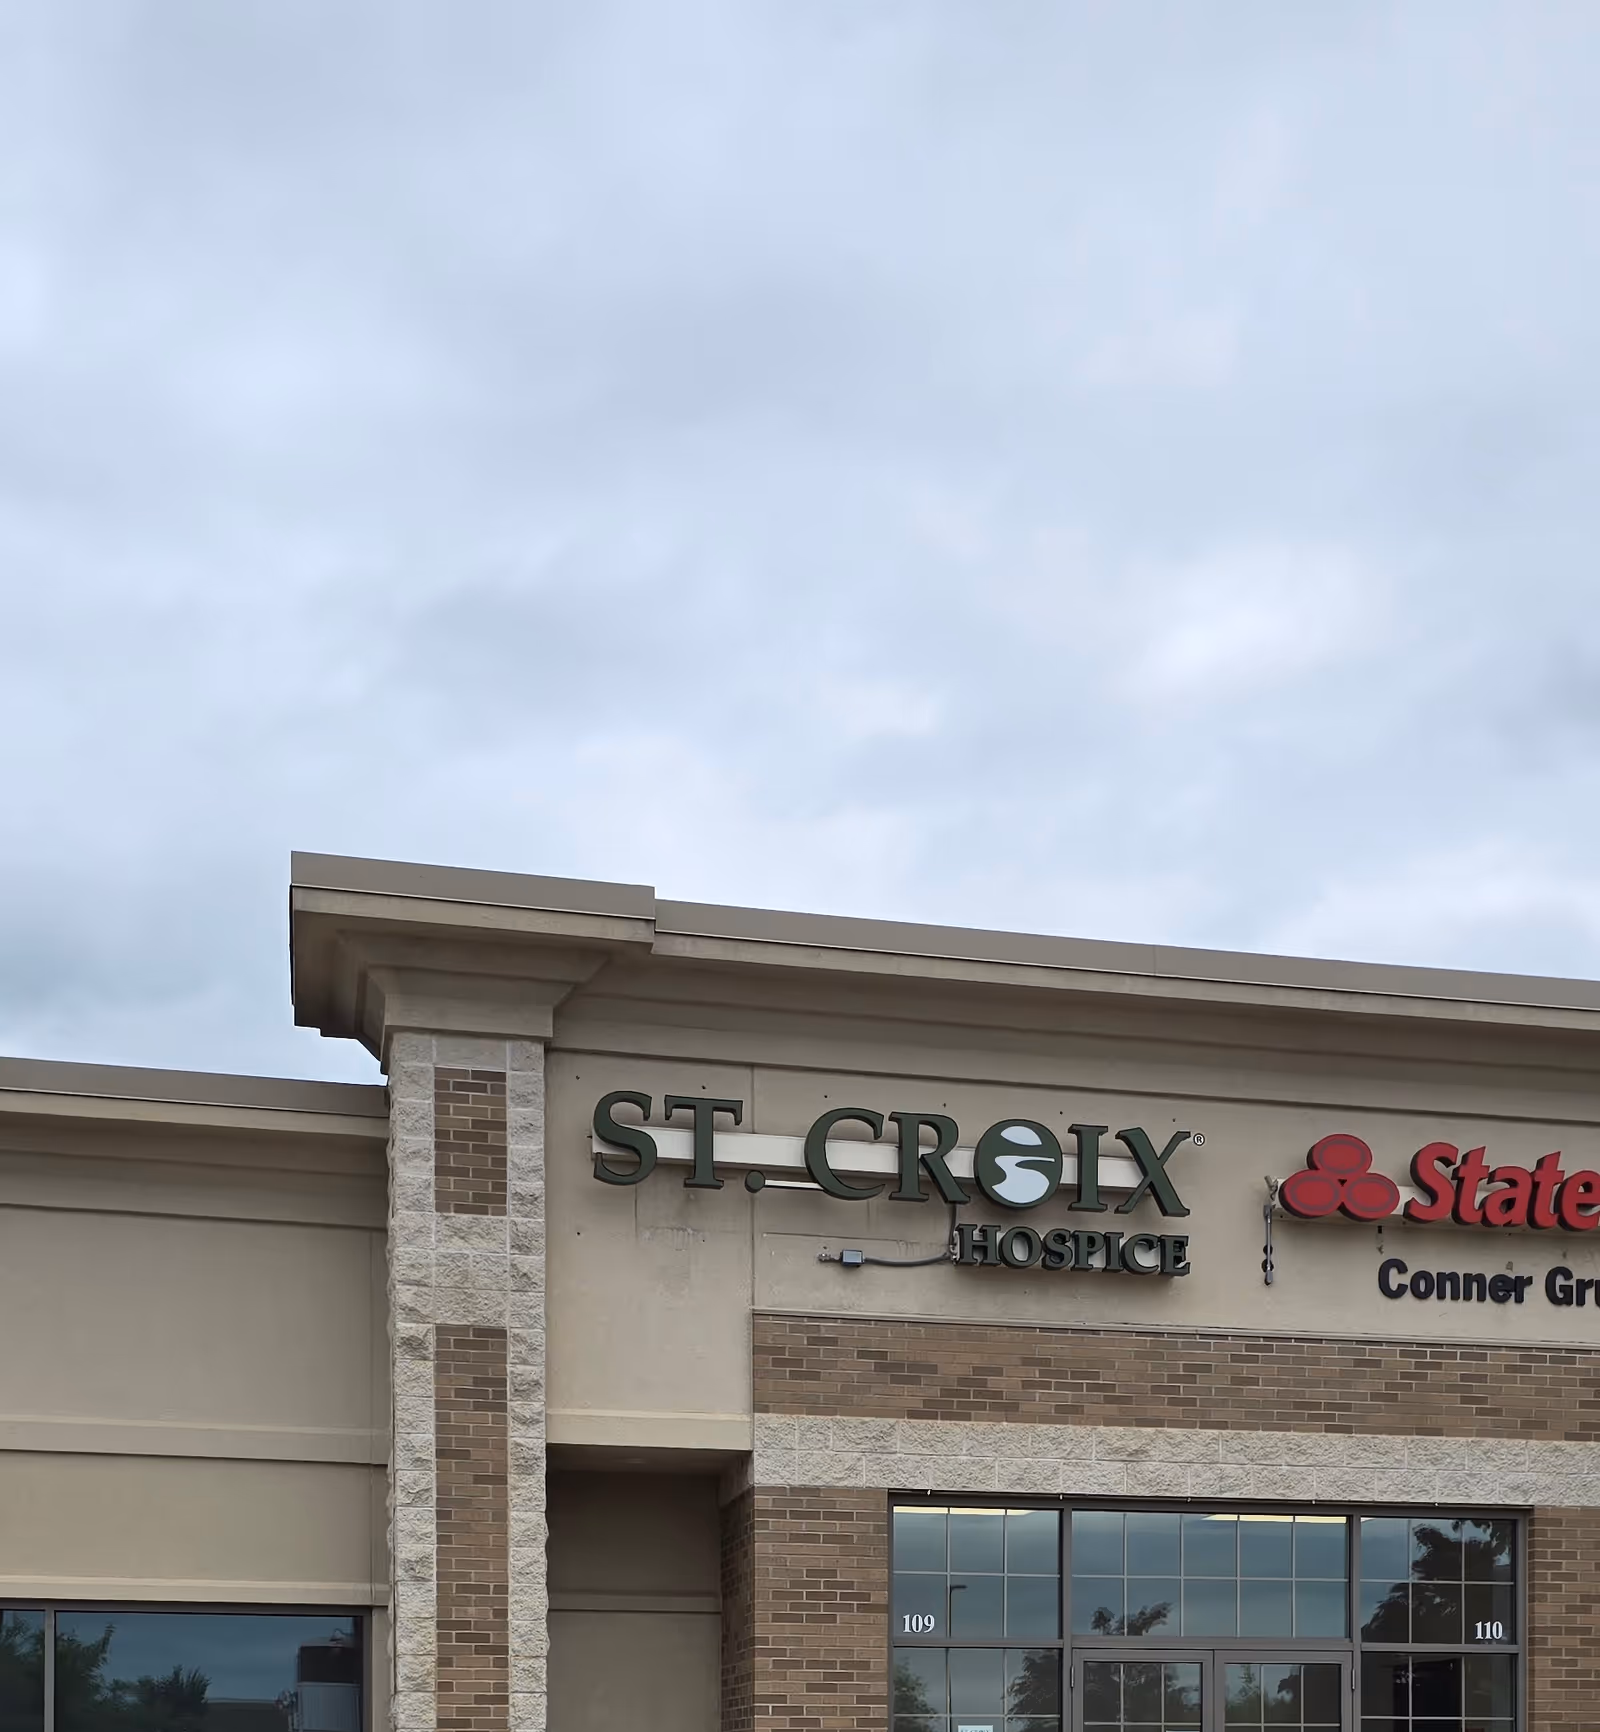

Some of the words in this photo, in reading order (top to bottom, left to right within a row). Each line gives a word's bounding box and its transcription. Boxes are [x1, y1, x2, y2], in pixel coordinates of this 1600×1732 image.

[593, 1090, 765, 1194] ST.
[1403, 1141, 1600, 1231] State
[955, 1223, 1191, 1276] HOSPICE
[1378, 1258, 1533, 1304] Conner
[902, 1614, 935, 1633] 109
[1475, 1621, 1503, 1640] 110
